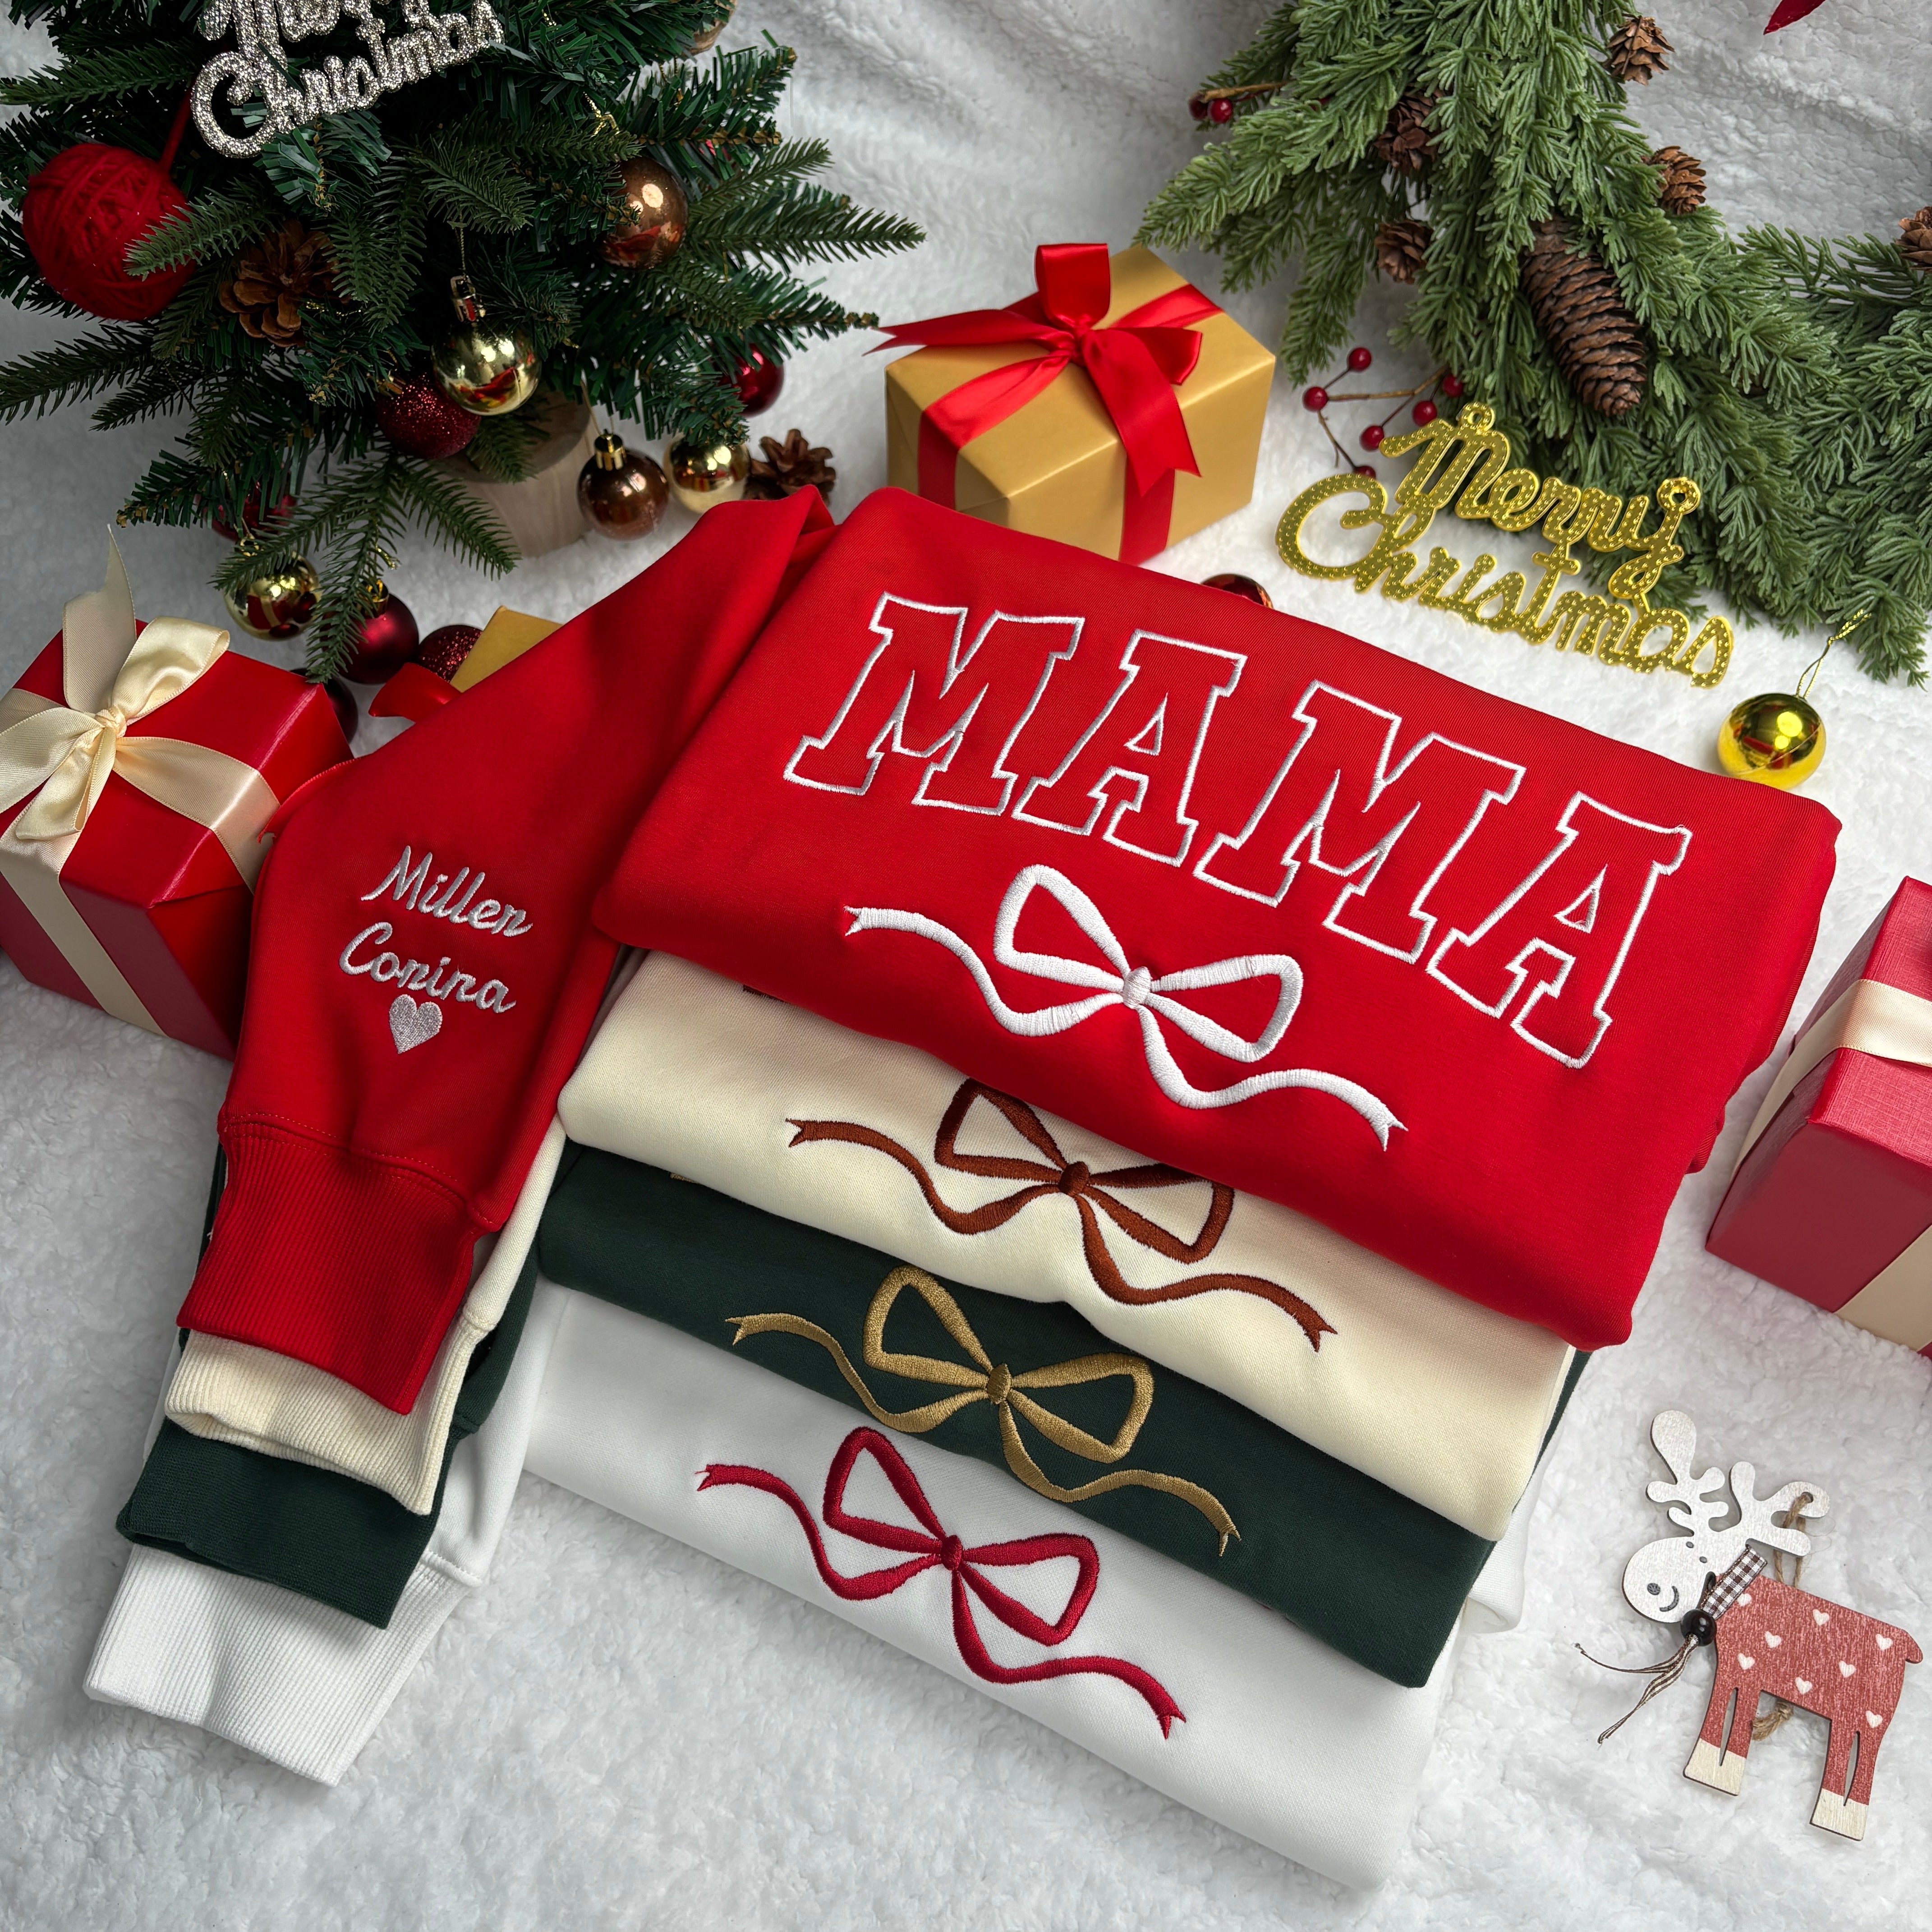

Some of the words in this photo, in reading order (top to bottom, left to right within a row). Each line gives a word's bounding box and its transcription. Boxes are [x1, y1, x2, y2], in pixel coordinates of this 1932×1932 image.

[190, 0, 505, 158] Christmas
[1275, 473, 1734, 690] Christmas
[1379, 415, 1691, 598] Merry
[361, 845, 533, 937] Miller
[783, 592, 1692, 1068] MAMA
[339, 922, 517, 1013] Corina
